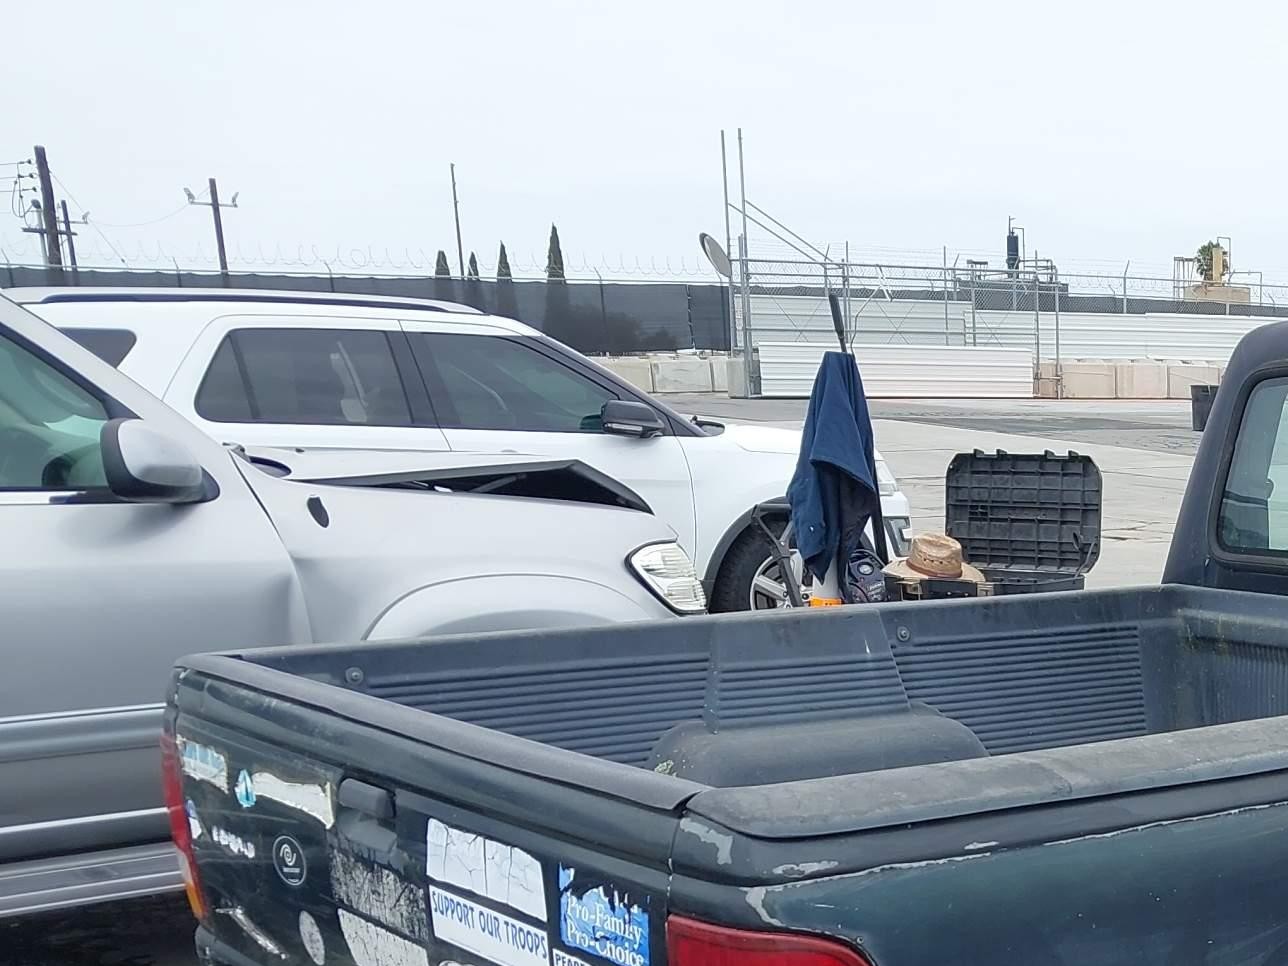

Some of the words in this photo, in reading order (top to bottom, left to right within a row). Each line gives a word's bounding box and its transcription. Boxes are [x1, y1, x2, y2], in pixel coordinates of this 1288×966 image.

[432, 891, 475, 929] SUPPORT
[478, 910, 503, 943] OUR
[504, 921, 548, 959] TROOPS
